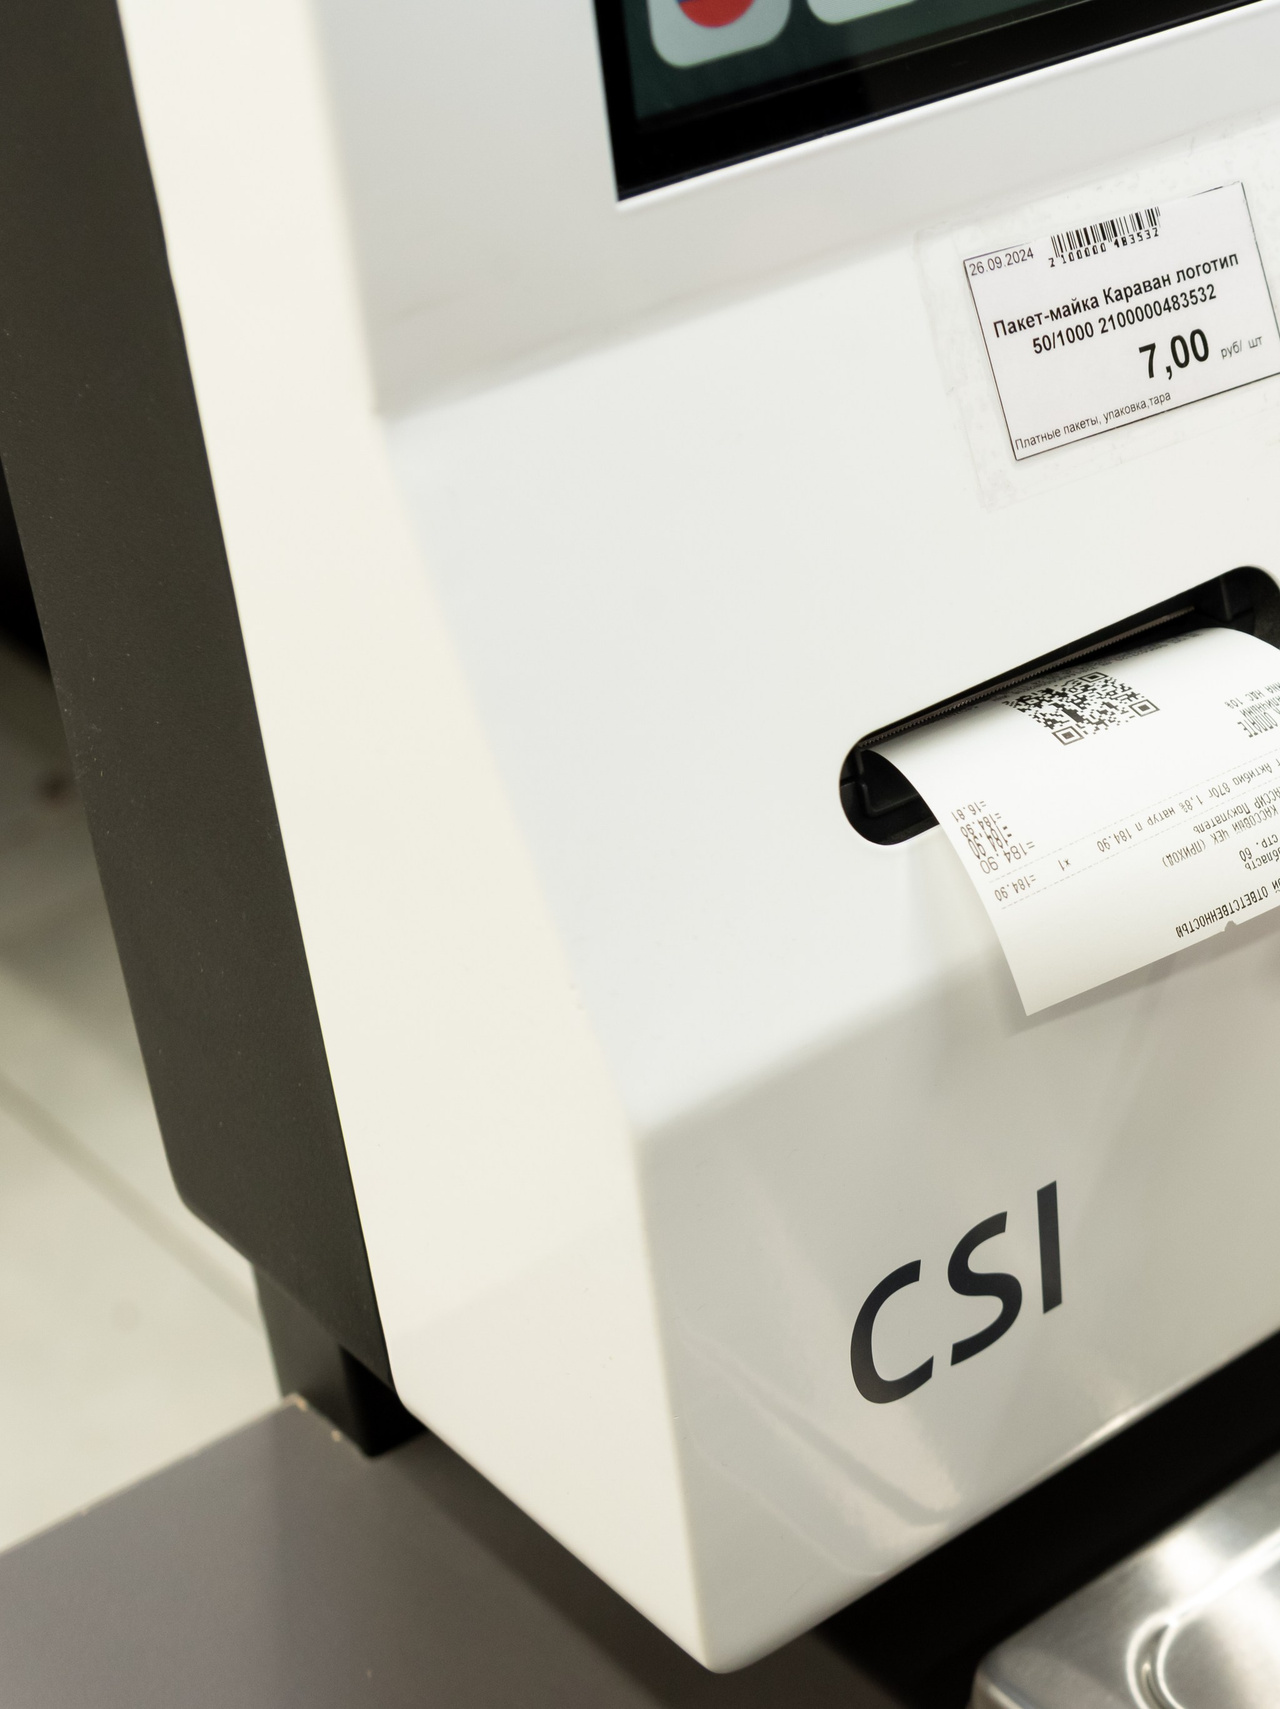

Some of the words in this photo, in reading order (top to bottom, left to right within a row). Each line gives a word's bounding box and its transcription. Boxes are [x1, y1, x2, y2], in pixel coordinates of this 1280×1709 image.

[969, 247, 1035, 277] 26.09.2024
[993, 295, 1100, 338] Пакет-майка
[1102, 273, 1172, 306] Караван
[1175, 253, 1239, 284] логотип
[1032, 322, 1095, 354] 50/1000
[1098, 283, 1217, 335] 2100000483532
[1138, 328, 1211, 381] 7,00
[1220, 339, 1243, 360] руб/
[1248, 334, 1263, 349] шт
[1014, 427, 1061, 450] Платные
[1063, 417, 1102, 434] пакеты,
[1232, 762, 1273, 786] Актибио
[1208, 782, 1231, 799] 870г
[951, 801, 986, 822] =16.81
[1146, 806, 1176, 826] натур
[1192, 803, 1251, 834] Покупатель
[1096, 827, 1133, 853] 184.90
[1210, 829, 1231, 845] ЧЕК
[1256, 834, 1279, 849] стр.
[979, 841, 1036, 874] =184.90
[1161, 838, 1207, 868] (ПРИХОД)
[1238, 847, 1253, 862] 60
[994, 874, 1037, 901] =184.90
[1175, 885, 1269, 938] ОТВЕТСТВЕННОСТЬЮ
[850, 1180, 1062, 1404] CSI
